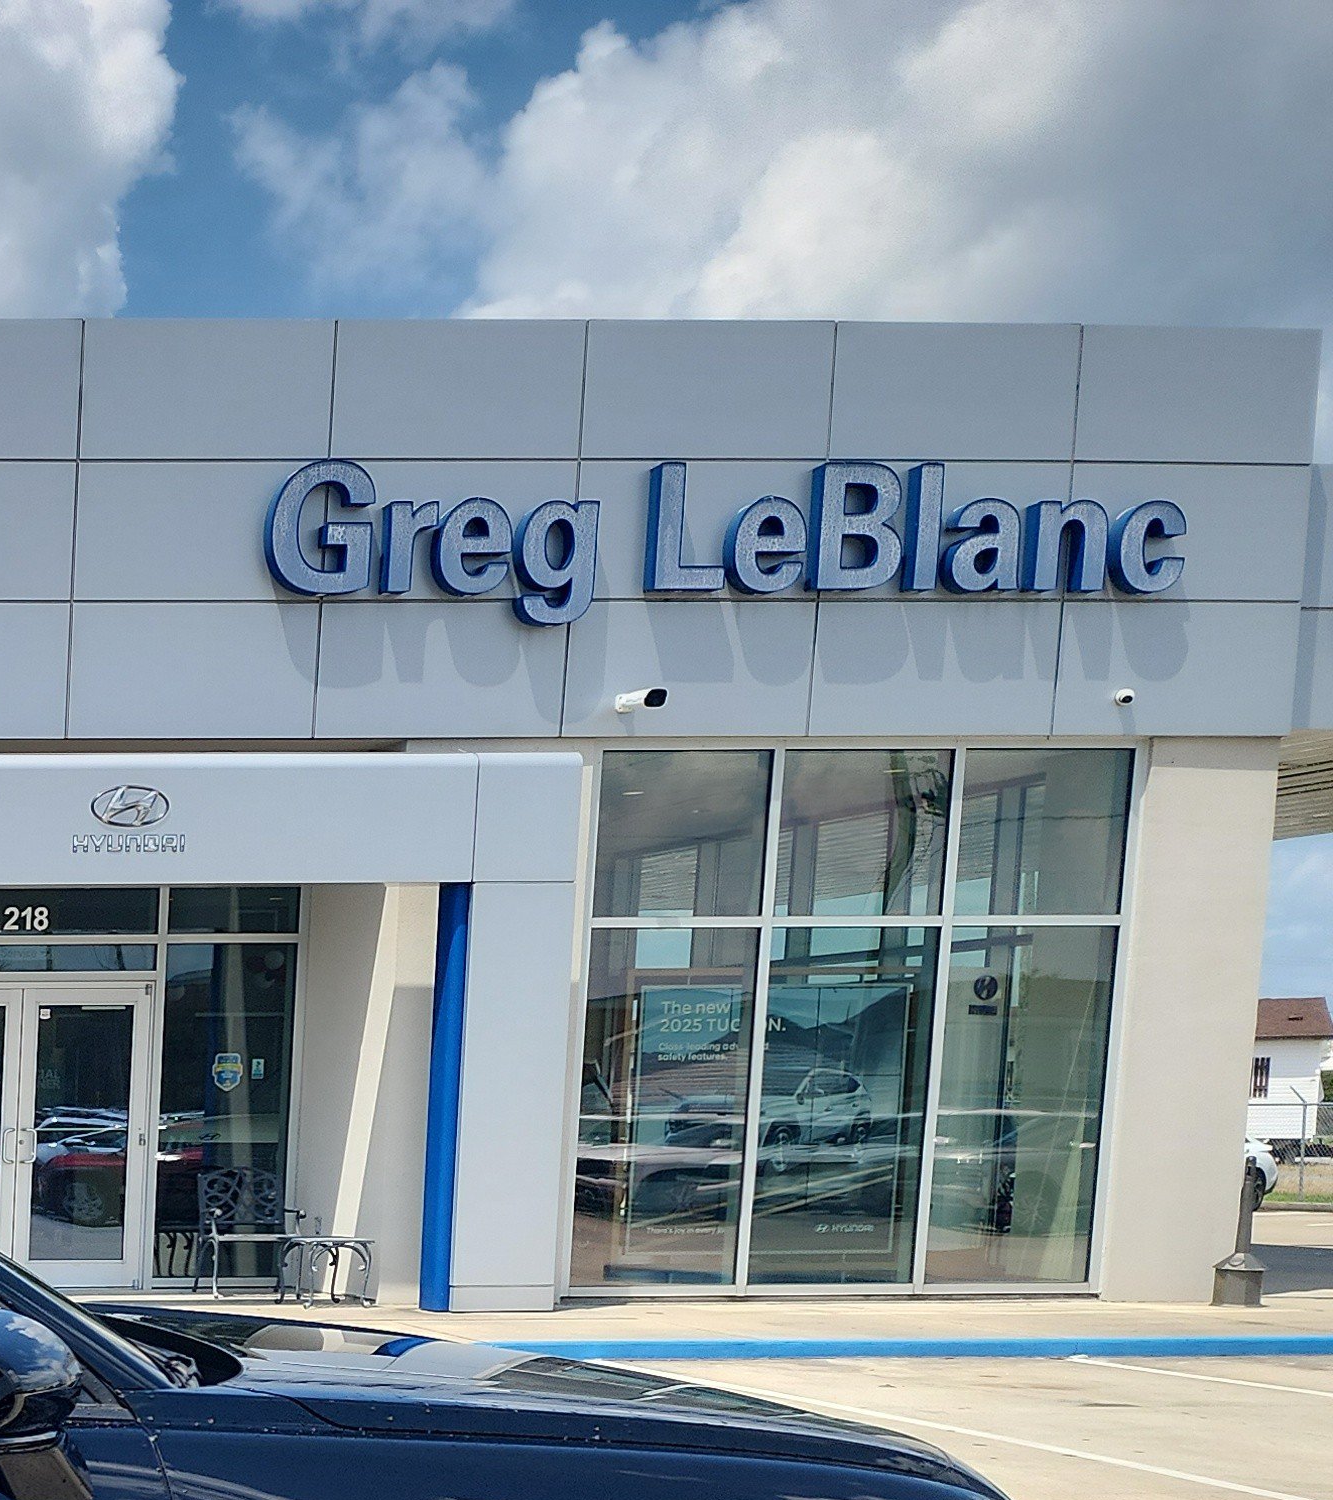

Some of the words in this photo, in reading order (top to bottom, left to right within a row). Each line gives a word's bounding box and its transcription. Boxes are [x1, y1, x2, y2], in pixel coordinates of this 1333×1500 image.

[263, 458, 600, 628] Greg
[642, 460, 1188, 596] LeBlanc
[72, 834, 186, 853] HYUNDAI
[2, 906, 49, 931] 218
[662, 1001, 692, 1015] The
[695, 1003, 731, 1015] new
[660, 1018, 703, 1032] 2025
[707, 1017, 787, 1032] TUCN.
